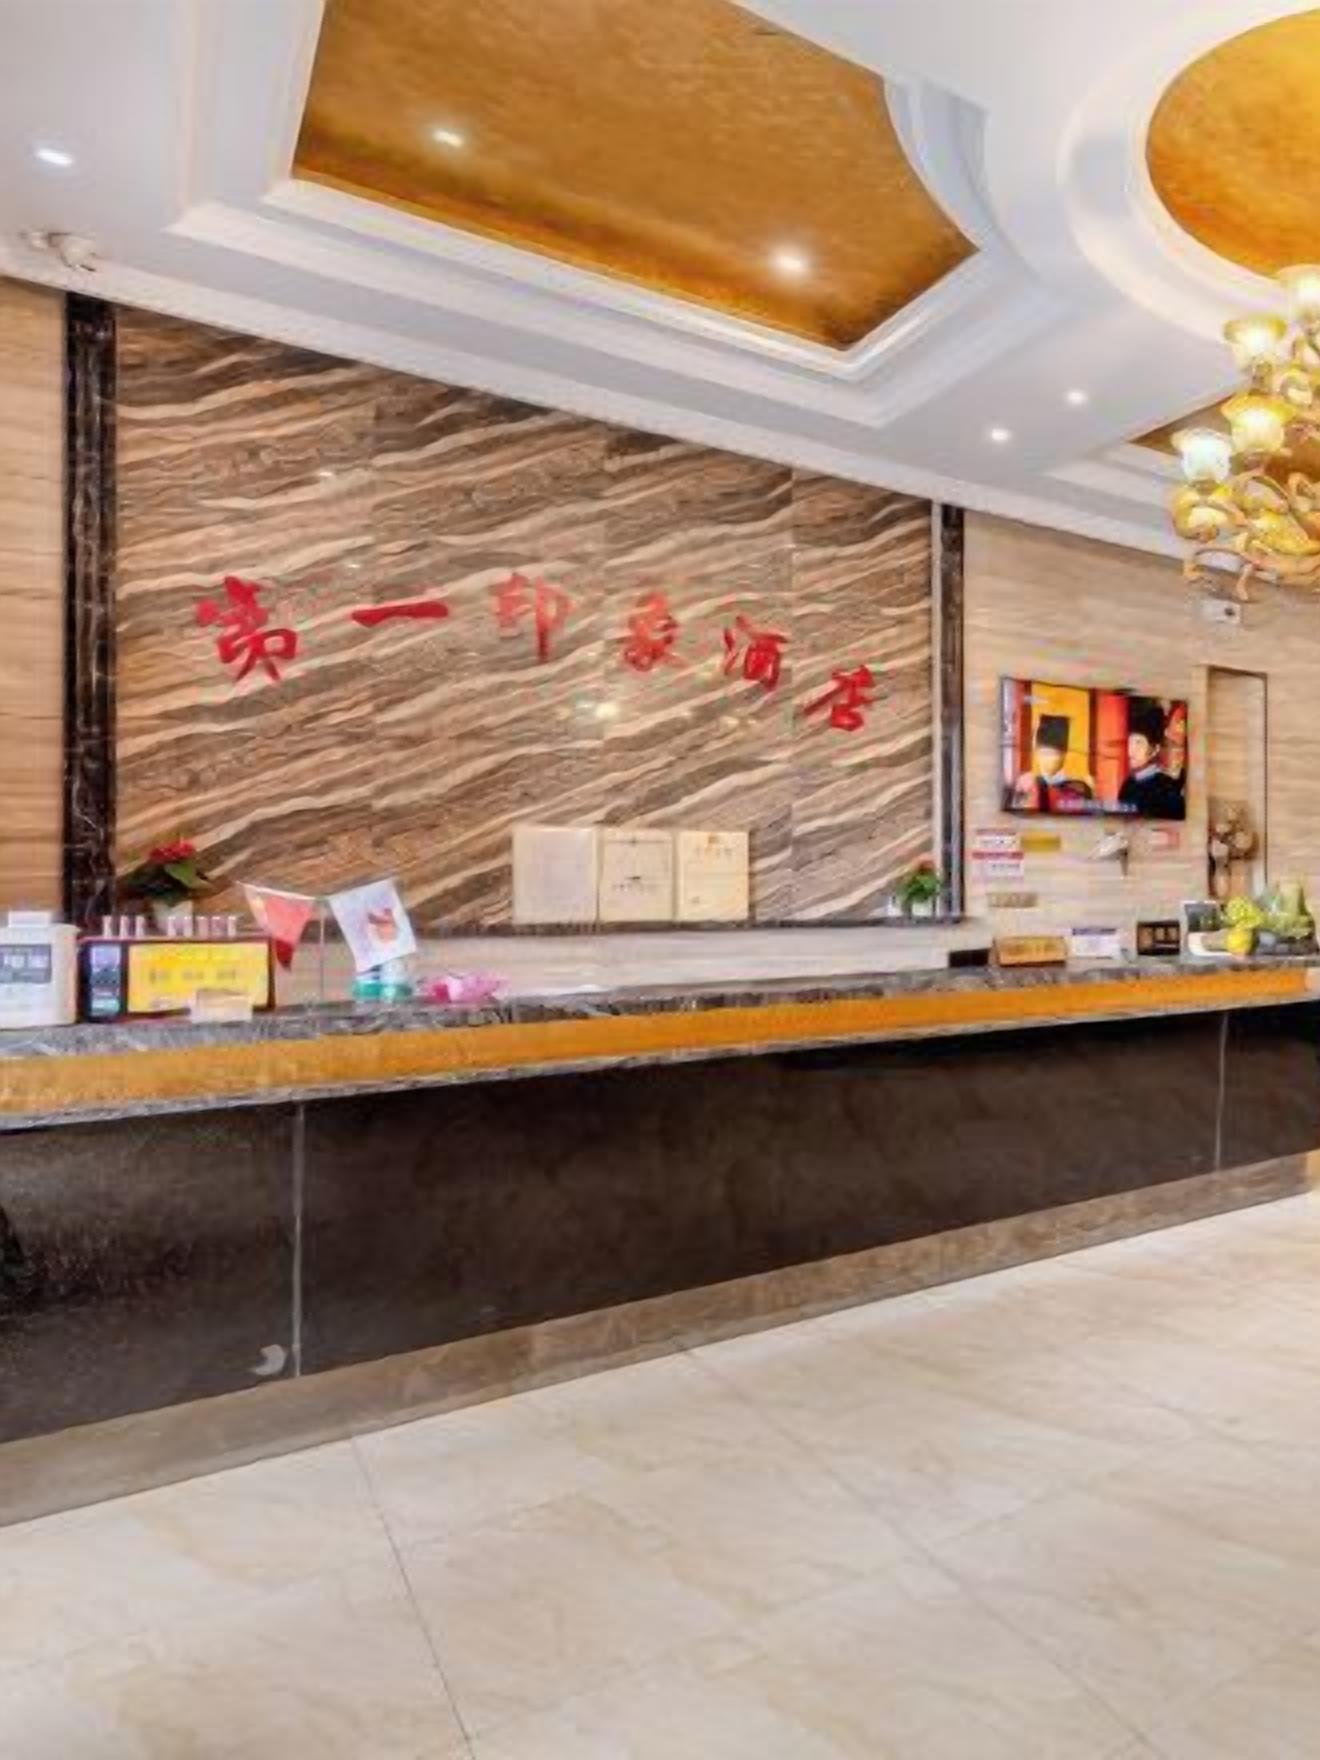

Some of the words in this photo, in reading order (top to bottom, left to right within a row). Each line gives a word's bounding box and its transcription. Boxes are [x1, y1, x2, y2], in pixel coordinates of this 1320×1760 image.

[194, 576, 876, 733] 第一印象酒店
